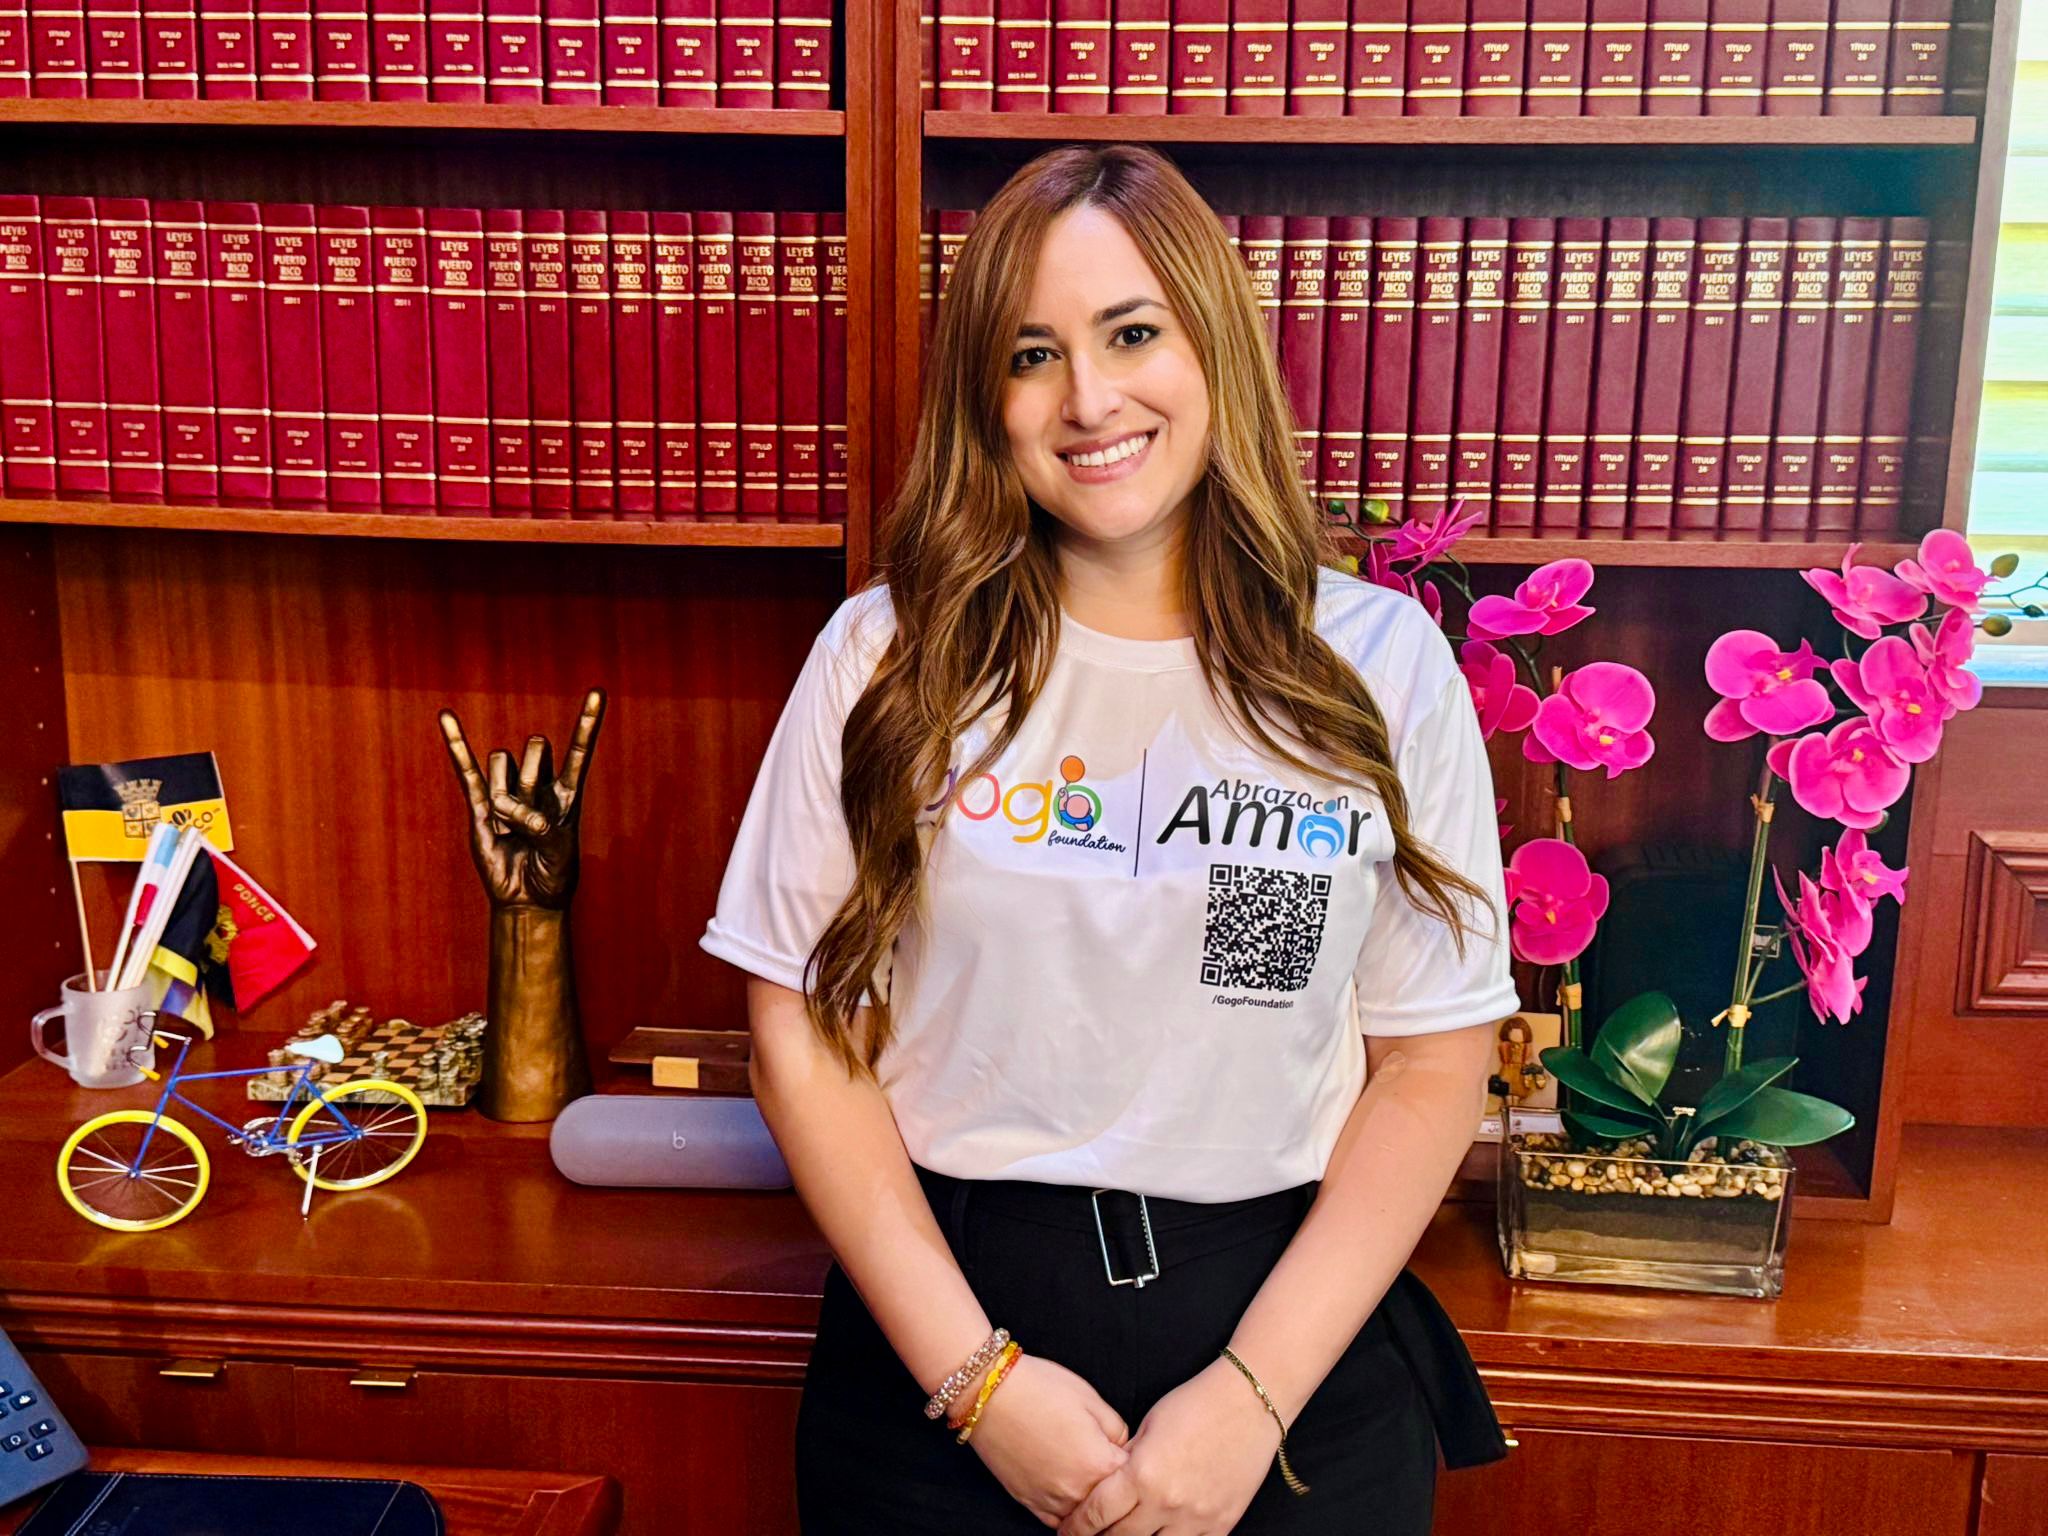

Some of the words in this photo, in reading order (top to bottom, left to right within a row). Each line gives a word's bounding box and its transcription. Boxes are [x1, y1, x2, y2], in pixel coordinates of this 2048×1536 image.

[1, 225, 28, 238] LEYES
[58, 228, 85, 241] LEYES
[111, 230, 138, 242] LEYES
[167, 231, 194, 244] LEYES
[223, 233, 250, 246] LEYES
[276, 236, 303, 249] LEYES
[330, 238, 357, 250] LEYES
[386, 237, 413, 250] LEYES
[441, 240, 468, 254] LEYES
[491, 242, 518, 254] LEYES
[532, 242, 559, 256] LEYES
[573, 244, 600, 257] LEYES
[615, 243, 642, 257] LEYES
[657, 244, 684, 258] LEYES
[700, 243, 727, 257] LEYES
[744, 245, 771, 258] LEYES
[787, 246, 814, 259] LEYES
[828, 246, 846, 257] LEY
[943, 245, 962, 256] LEY
[1249, 250, 1278, 263] LEYES
[1295, 250, 1324, 263] LEYES
[1339, 249, 1368, 263] LEYES
[1382, 251, 1411, 264] LEYES
[1429, 252, 1458, 265] LEYES
[1472, 250, 1501, 263] LEYES
[1518, 251, 1547, 265] LEYES
[1565, 253, 1594, 265] LEYES
[1612, 252, 1641, 265] LEYES
[1657, 251, 1686, 264] LEYES
[1705, 253, 1734, 266] LEYES
[1751, 252, 1780, 265] LEYES
[1798, 251, 1827, 265] LEYES
[1844, 252, 1873, 264] LEYES
[1893, 251, 1922, 264] LEYES
[439, 260, 472, 272] PUERTO
[490, 261, 522, 273] PUERTO
[530, 262, 563, 274] PUERTO
[572, 263, 604, 275] PUERTO
[614, 263, 645, 275] PUERTO
[655, 264, 688, 276] PUERTO
[699, 264, 731, 276] PUERTO
[741, 265, 774, 277] PUERTO
[784, 266, 817, 278] PUERTO
[826, 265, 848, 276] PUER
[446, 271, 467, 281] RICO
[495, 272, 515, 282] RICO
[537, 273, 557, 283] RICO
[578, 274, 599, 284] RICO
[619, 274, 640, 284] RICO
[662, 275, 683, 285] RICO
[705, 275, 726, 285] RICO
[748, 276, 769, 286] RICO
[791, 277, 812, 287] RICO
[832, 276, 847, 287] RIC
[1291, 269, 1325, 282] PUERTO
[1335, 269, 1369, 282] PUERTO
[1379, 270, 1413, 283] PUERTO
[1425, 272, 1459, 285] PUERTO
[1467, 270, 1502, 283] PUERTO
[1513, 271, 1548, 284] PUERTO
[1561, 272, 1596, 285] PUERTO
[1607, 271, 1643, 284] PUERTO
[1653, 271, 1688, 284] PUERTO
[1700, 273, 1736, 286] PUERTO
[1746, 271, 1782, 284] PUERTO
[1793, 271, 1829, 284] PUERTO
[1840, 271, 1875, 284] PUERTO
[1888, 271, 1923, 284] PUERTO
[1297, 281, 1318, 292] RICO
[1341, 281, 1362, 292] RICO
[1384, 282, 1406, 293] RICO
[1432, 284, 1453, 295] RICO
[1473, 282, 1494, 293] RICO
[1520, 283, 1541, 294] RICO
[1566, 284, 1589, 295] RICO
[1612, 283, 1634, 294] RICO
[1658, 283, 1679, 294] RICO
[1705, 285, 1727, 296] RICO
[1751, 283, 1773, 294] RICO
[1798, 283, 1821, 294] RICO
[1844, 283, 1867, 294] RICO
[1893, 283, 1914, 294] RICO
[1156, 785, 1372, 858] Amor
[1048, 829, 1126, 853] foundation
